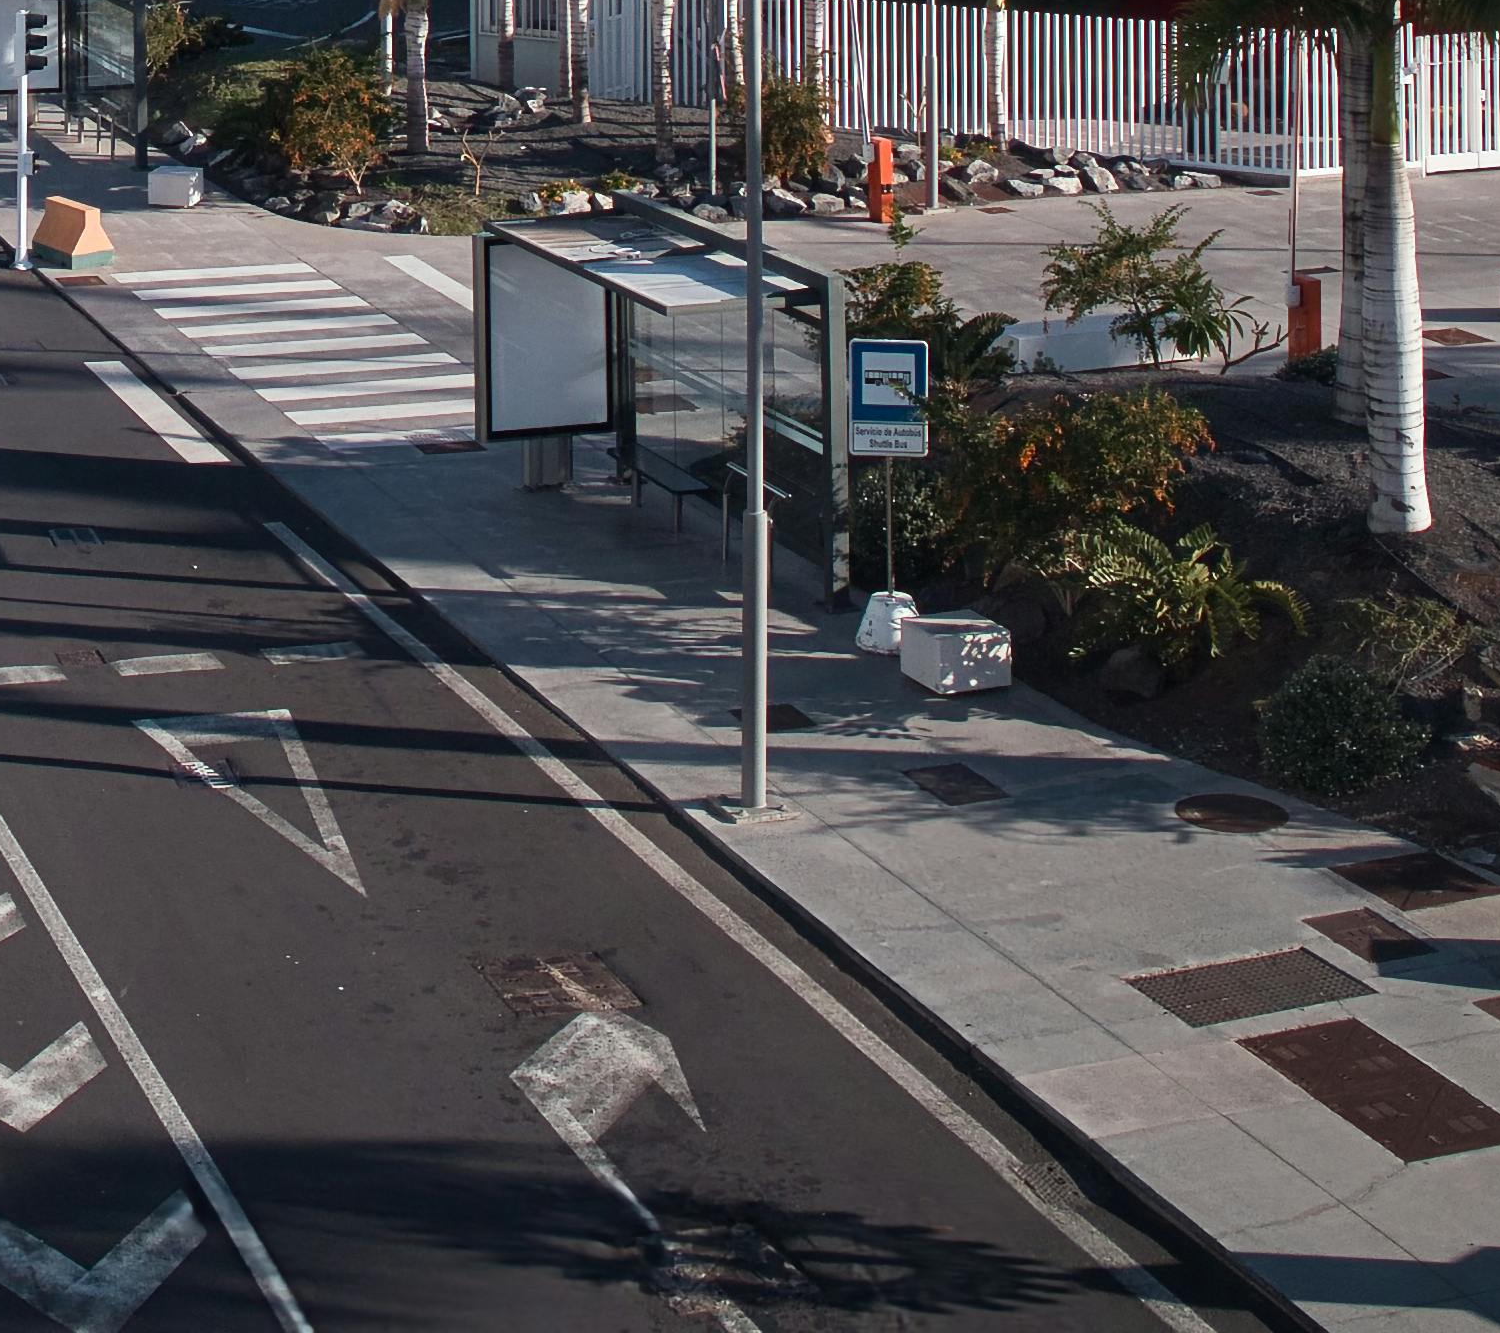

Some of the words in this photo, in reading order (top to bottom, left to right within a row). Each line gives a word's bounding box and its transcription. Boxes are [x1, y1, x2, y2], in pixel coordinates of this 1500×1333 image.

[855, 426, 882, 436] Servicio
[884, 427, 892, 436] de
[869, 439, 893, 448] Shuttle
[894, 439, 908, 448] Bus
